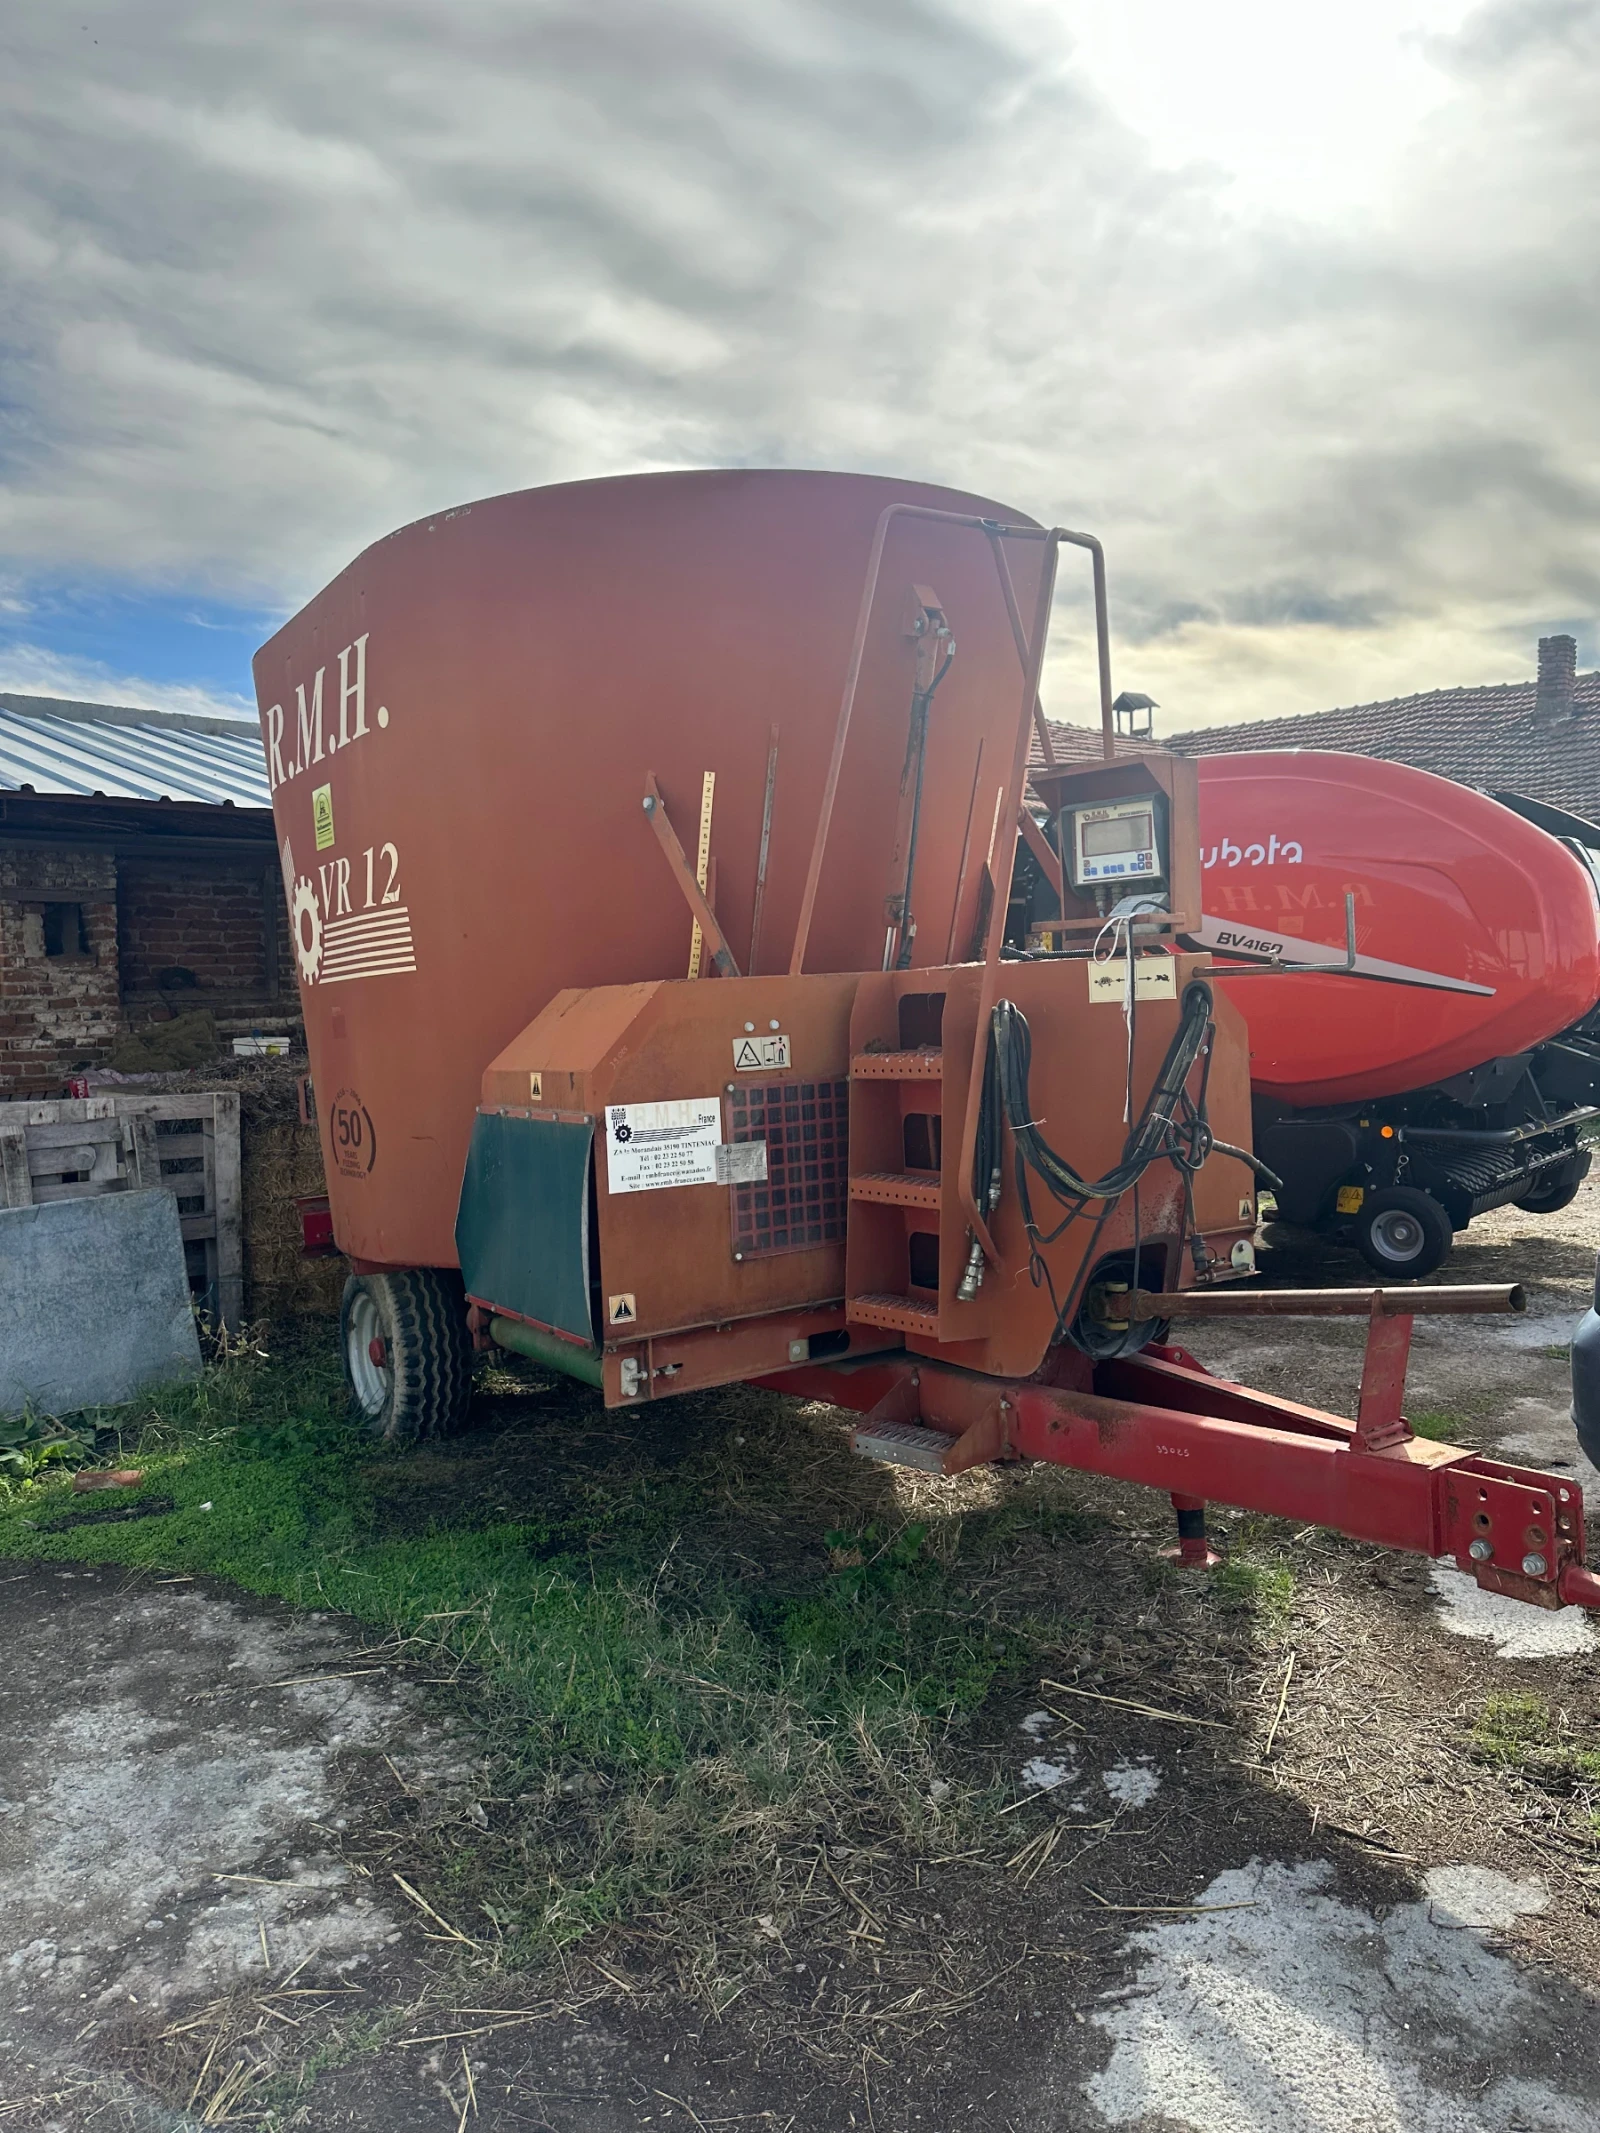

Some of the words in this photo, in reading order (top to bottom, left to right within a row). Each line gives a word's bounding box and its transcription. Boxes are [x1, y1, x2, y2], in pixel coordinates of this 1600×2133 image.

[266, 632, 389, 793] R.M.H.
[1200, 834, 1303, 869] ubota
[318, 857, 353, 920] VR
[363, 842, 401, 908] 12
[1216, 931, 1284, 954] BV4160
[338, 1109, 362, 1147] 50
[698, 1114, 716, 1124] France
[344, 1150, 357, 1159] YEARS
[632, 1146, 662, 1154] Morandais
[681, 1140, 716, 1148] TINTENIAC
